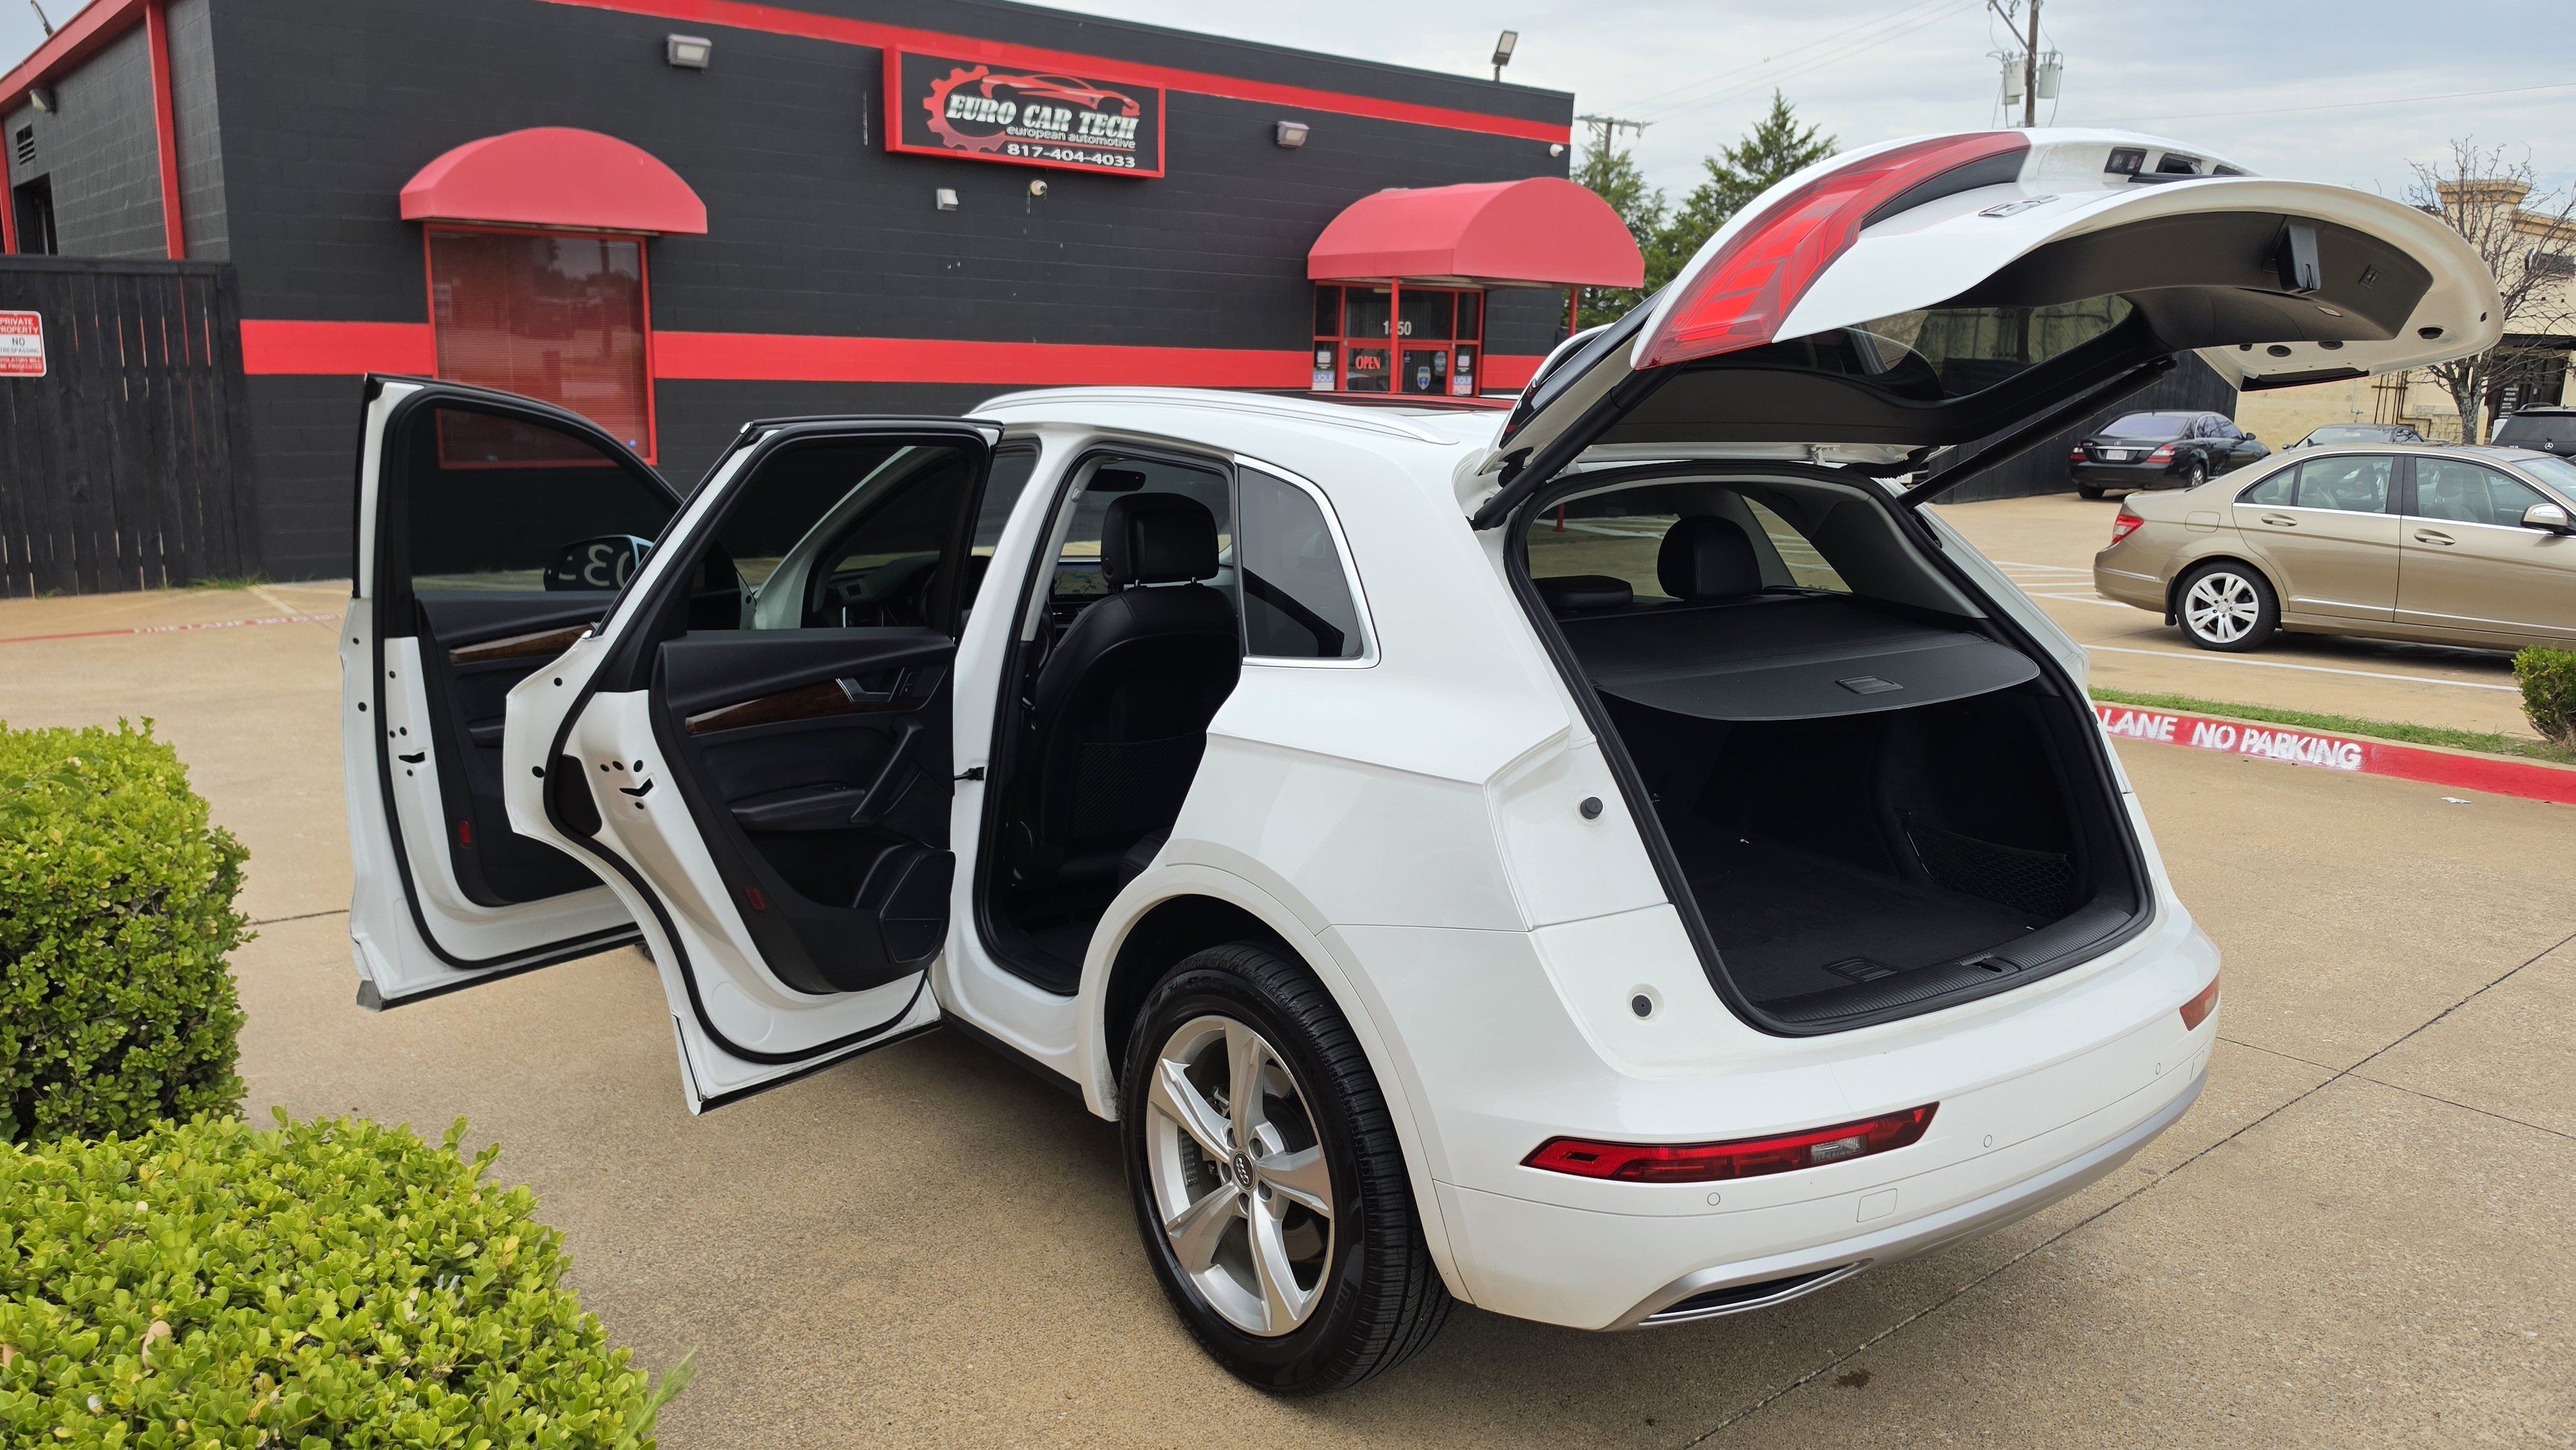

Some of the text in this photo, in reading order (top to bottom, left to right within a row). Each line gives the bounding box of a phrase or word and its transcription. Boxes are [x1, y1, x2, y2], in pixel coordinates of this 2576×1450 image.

[945, 95, 1139, 140] EURO CAR TECH
[1007, 126, 1136, 149] european automotive
[1007, 143, 1135, 168] 817-404-4033
[0, 317, 33, 326] PRIVATE
[1383, 321, 1412, 335] 150
[0, 325, 39, 334] ROPERTY
[12, 337, 25, 347] NO
[1356, 355, 1381, 370] OPEN
[2101, 709, 2362, 771] LANE NO PARKING
